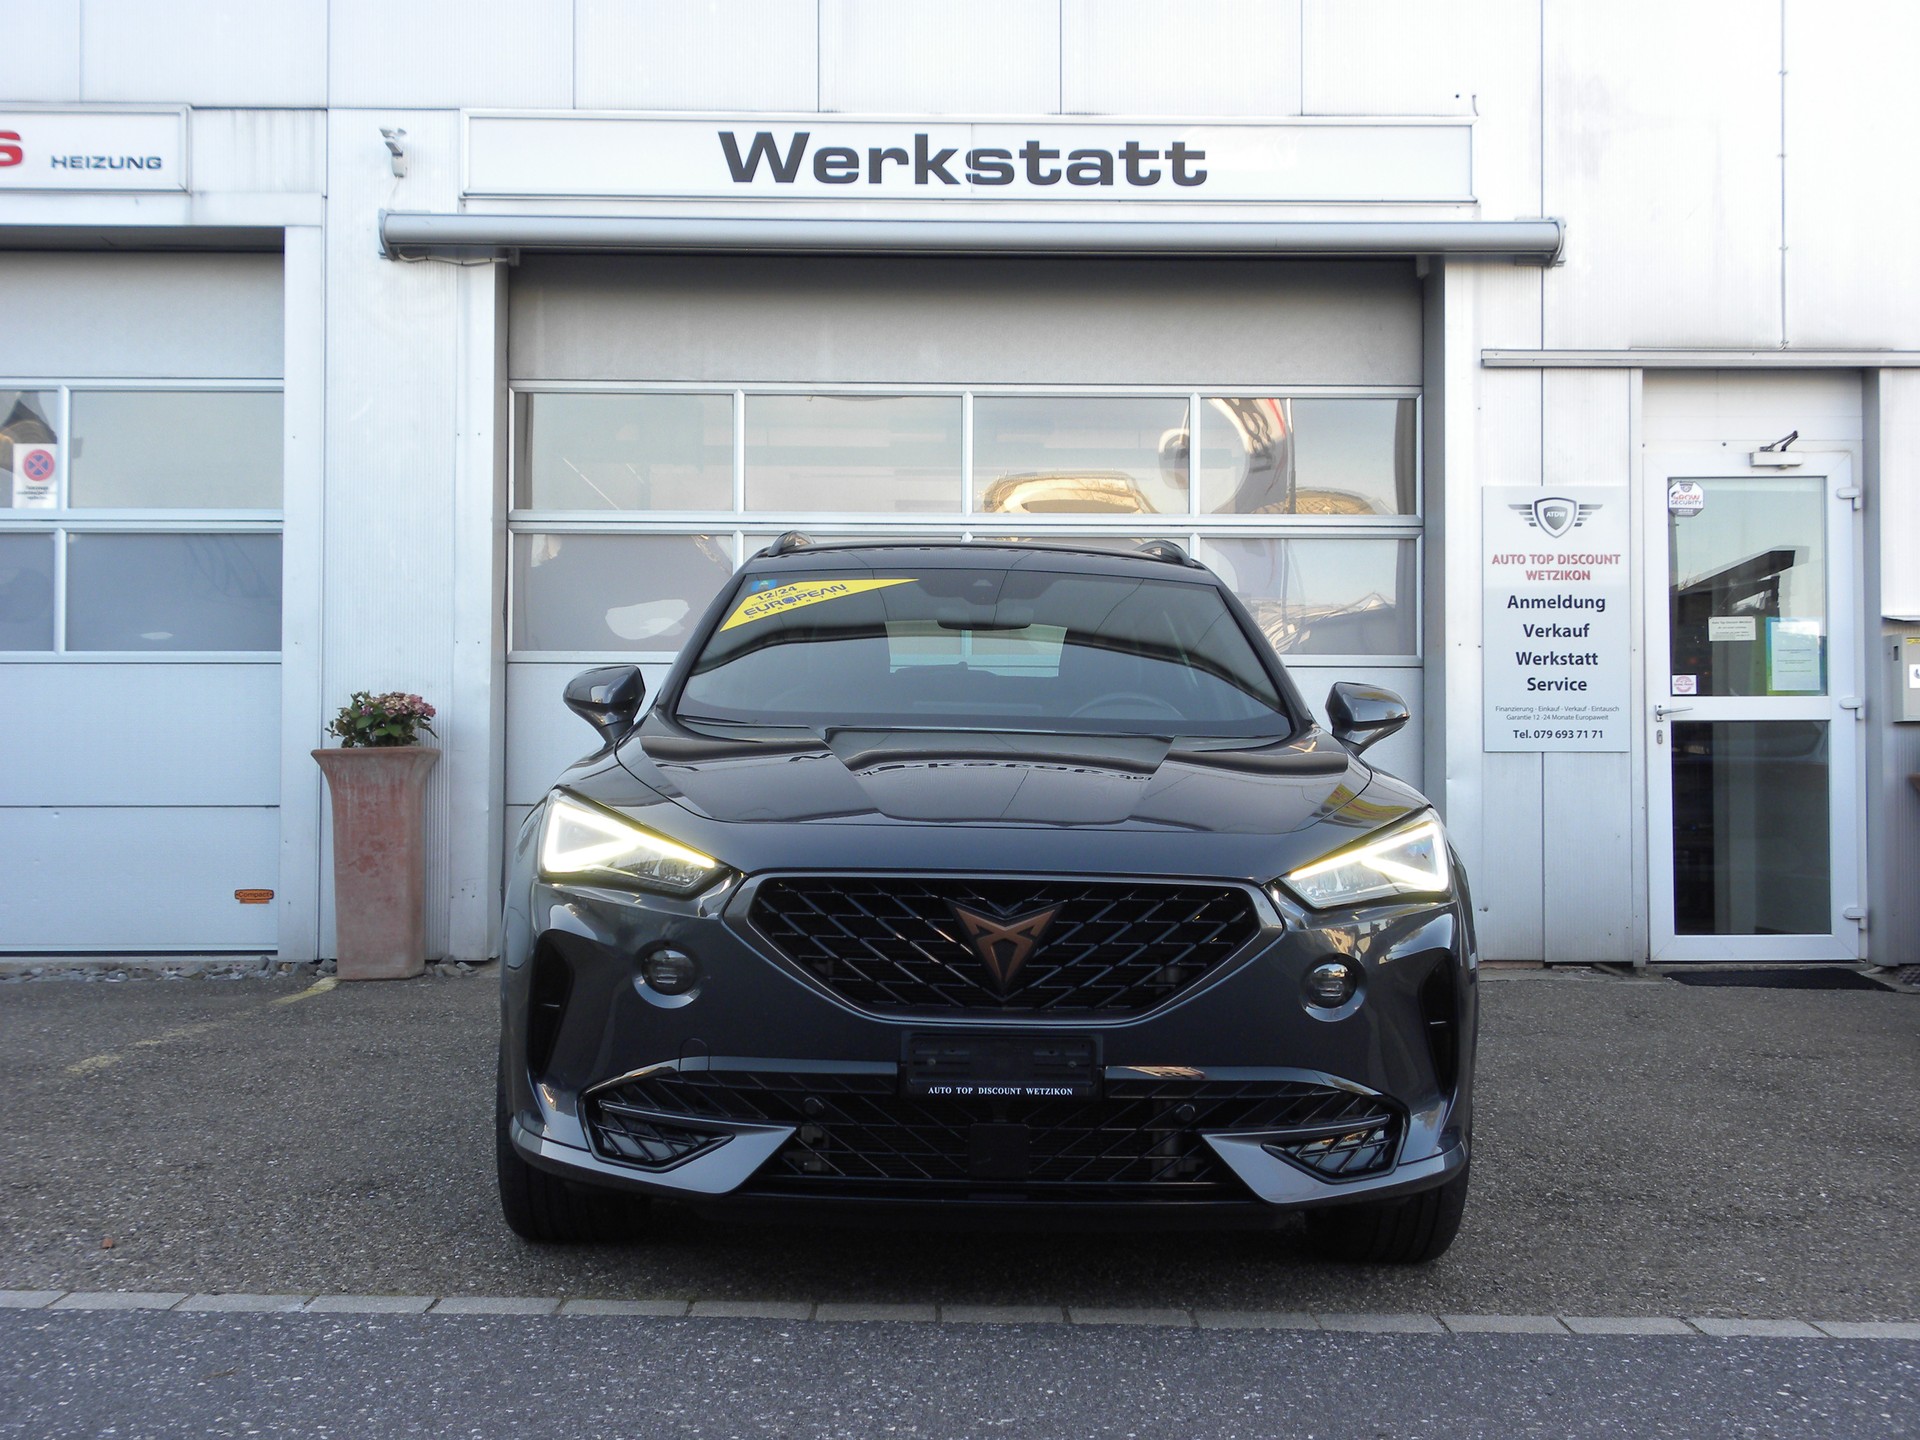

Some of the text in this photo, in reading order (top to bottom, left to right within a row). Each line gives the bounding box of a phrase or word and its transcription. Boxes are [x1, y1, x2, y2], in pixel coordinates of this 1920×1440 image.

[51, 155, 162, 170] HEIZUNG
[717, 131, 1207, 187] Werkstatt
[1492, 554, 1621, 565] AUTO TOP DISCOUNT
[1526, 570, 1590, 581] WETZIKON
[743, 583, 847, 616] EUROPEAN
[756, 585, 797, 601] 12/24
[1507, 594, 1606, 612] Anmeldung
[1523, 623, 1590, 638] Verkauf
[1516, 651, 1599, 666] Werkstatt
[1527, 677, 1587, 691] Service
[1513, 730, 1603, 739] Tel. 079 693 71 71
[928, 1086, 1073, 1096] AUTO TOP DISCOUNT WETZIKON
